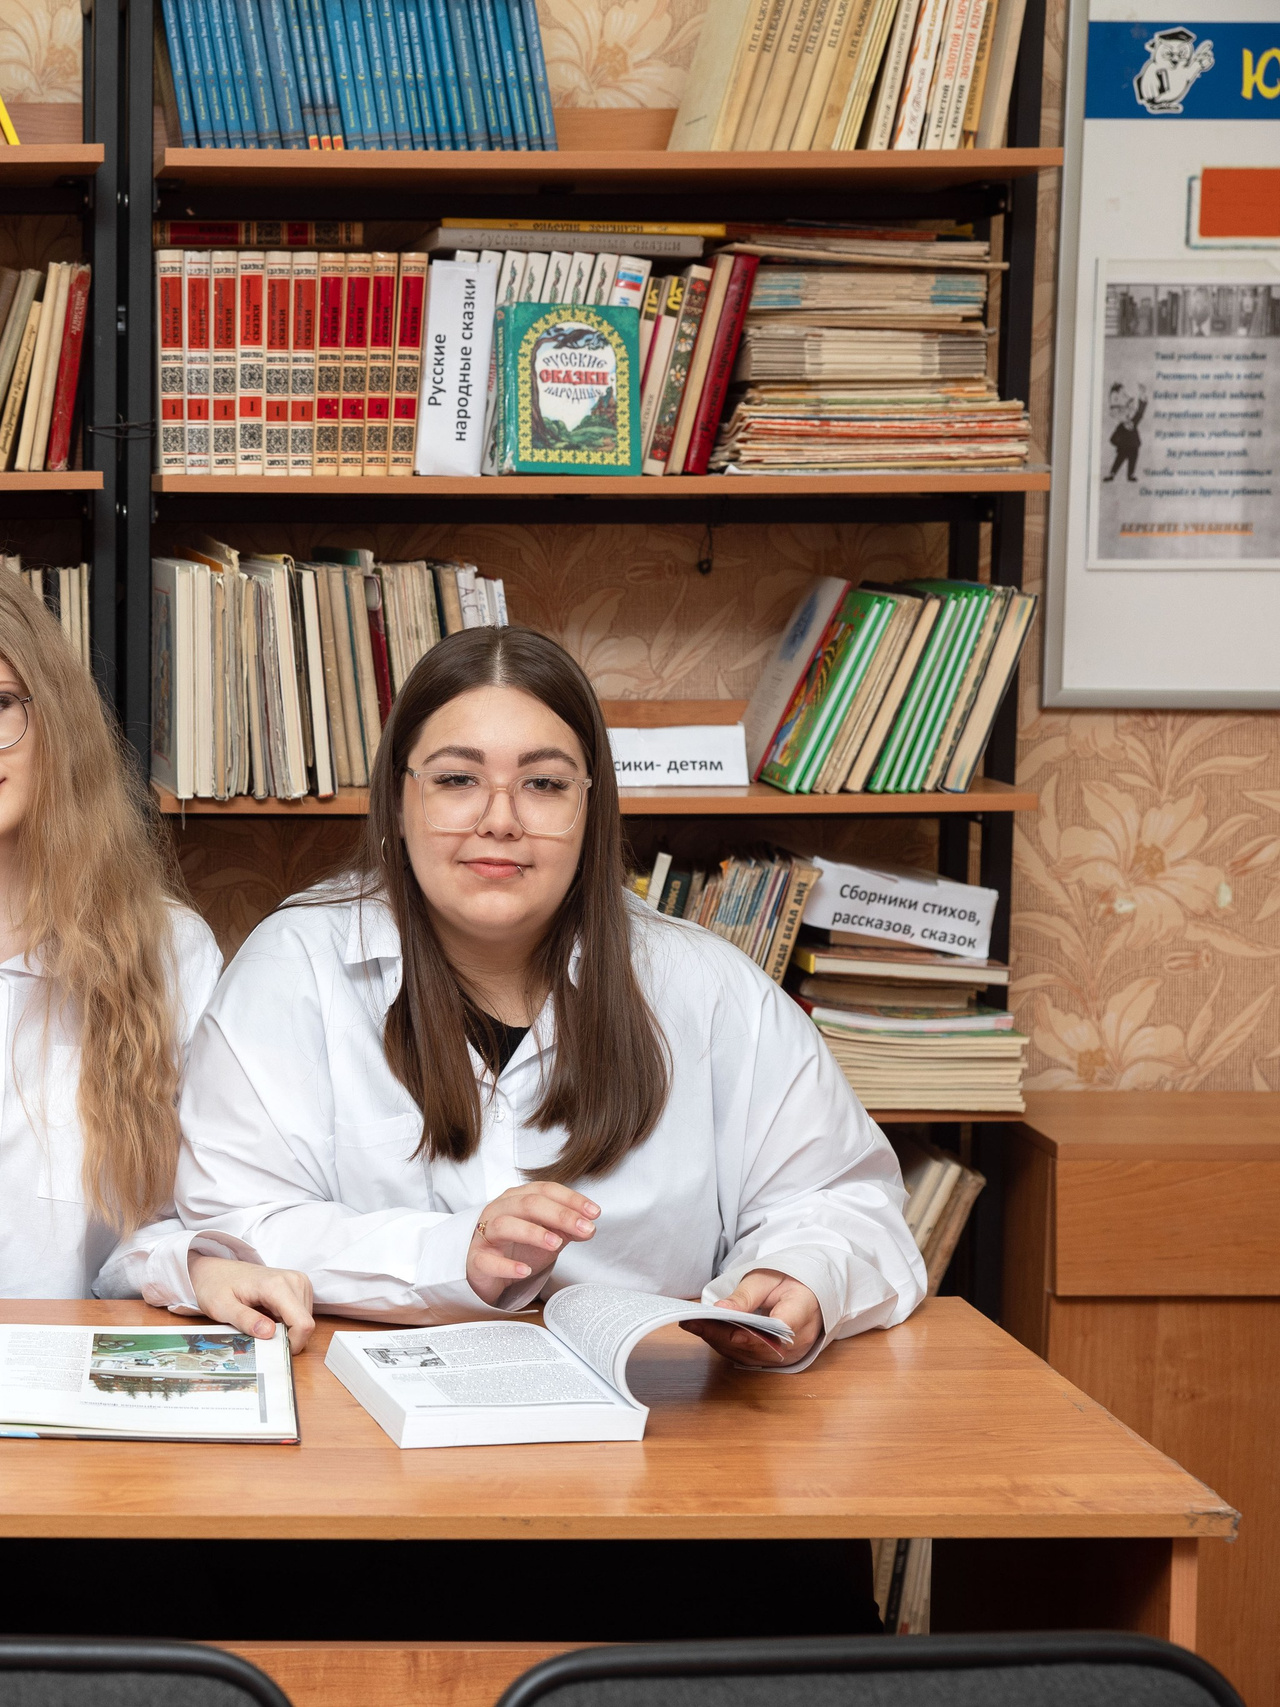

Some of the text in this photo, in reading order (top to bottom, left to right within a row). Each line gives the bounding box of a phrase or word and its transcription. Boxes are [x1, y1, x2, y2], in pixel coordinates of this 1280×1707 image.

[754, 0, 769, 31] БАЖО
[769, 0, 785, 31] БАЖО
[794, 0, 811, 31] БАЖО
[812, 0, 829, 32] БАЖО
[833, 0, 848, 26] БАЖО
[936, 85, 950, 129] ТОЛСТОЙ
[944, 34, 961, 80] ЗОЛОТОЙ
[951, 85, 965, 129] ТОЛСТОЙ
[960, 33, 976, 79] ЗОЛОТОЙ
[633, 238, 681, 253] СКАЗКИ
[172, 307, 180, 343] сказки
[225, 308, 233, 344] сказки
[252, 304, 260, 340] сказки
[304, 309, 312, 345] сказки
[428, 333, 446, 406] Русские
[455, 278, 476, 442] народные сказки
[539, 369, 609, 385] СКАЗКИ
[543, 352, 608, 369] РУССКИЕ
[544, 386, 604, 404] НАРОДНЫЕ
[1121, 521, 1254, 533] БЕРЕГИТЕ УЧЕБНИКИ!
[667, 758, 724, 775] детям
[839, 883, 982, 927] Сборники стихов,
[772, 944, 794, 980] СРЕДИ
[783, 911, 800, 942] БЕЛА
[831, 909, 978, 951] рассказов, сказок
